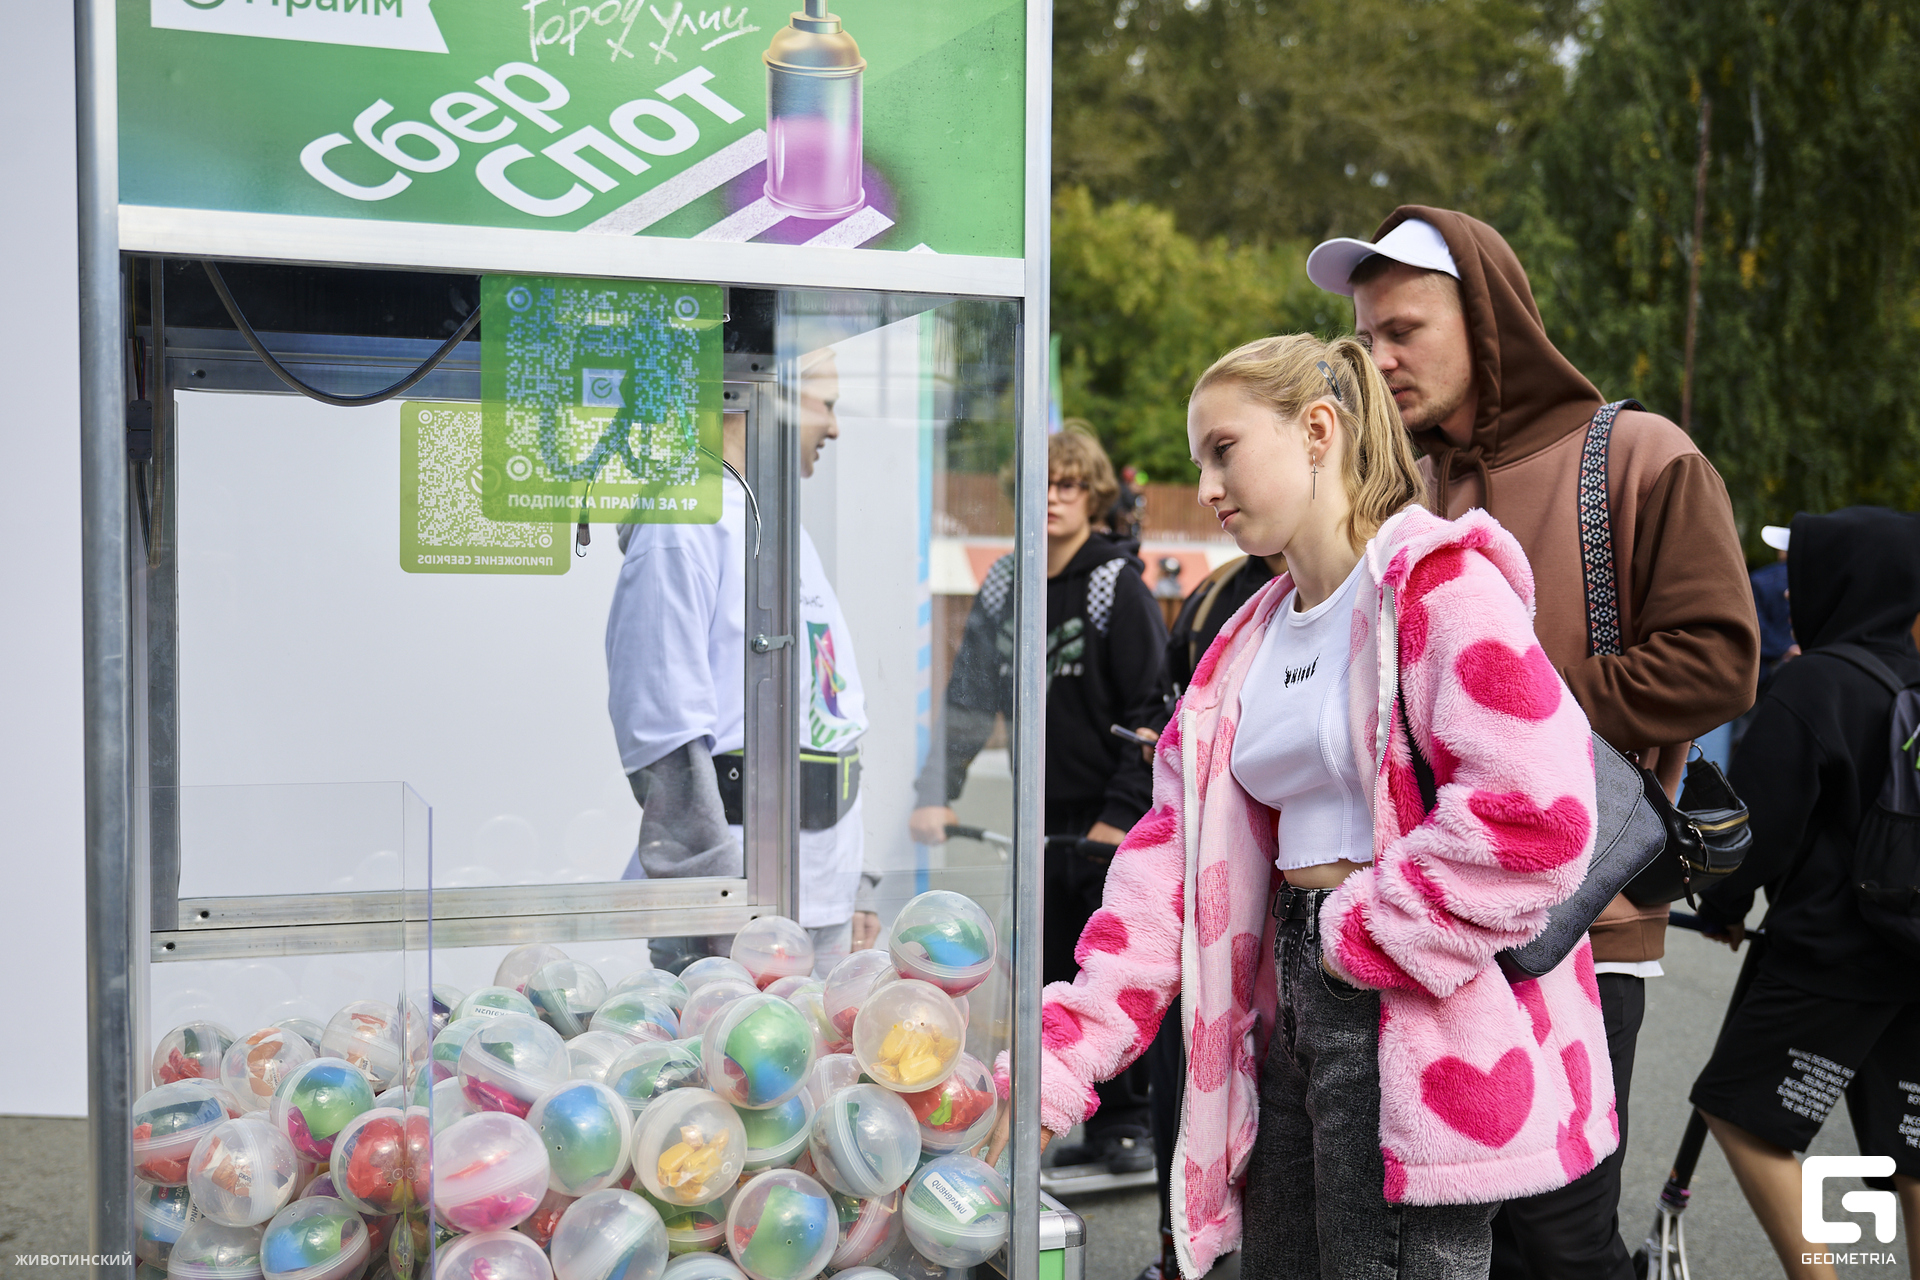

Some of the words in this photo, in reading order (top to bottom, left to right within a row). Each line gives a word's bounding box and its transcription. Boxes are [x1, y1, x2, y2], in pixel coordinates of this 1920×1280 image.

[300, 62, 570, 201] Сбер
[475, 66, 745, 217] Спот
[508, 494, 596, 509] ПОДПИСКА
[600, 493, 655, 510] ПРАЙМ
[658, 498, 678, 510] ЗА
